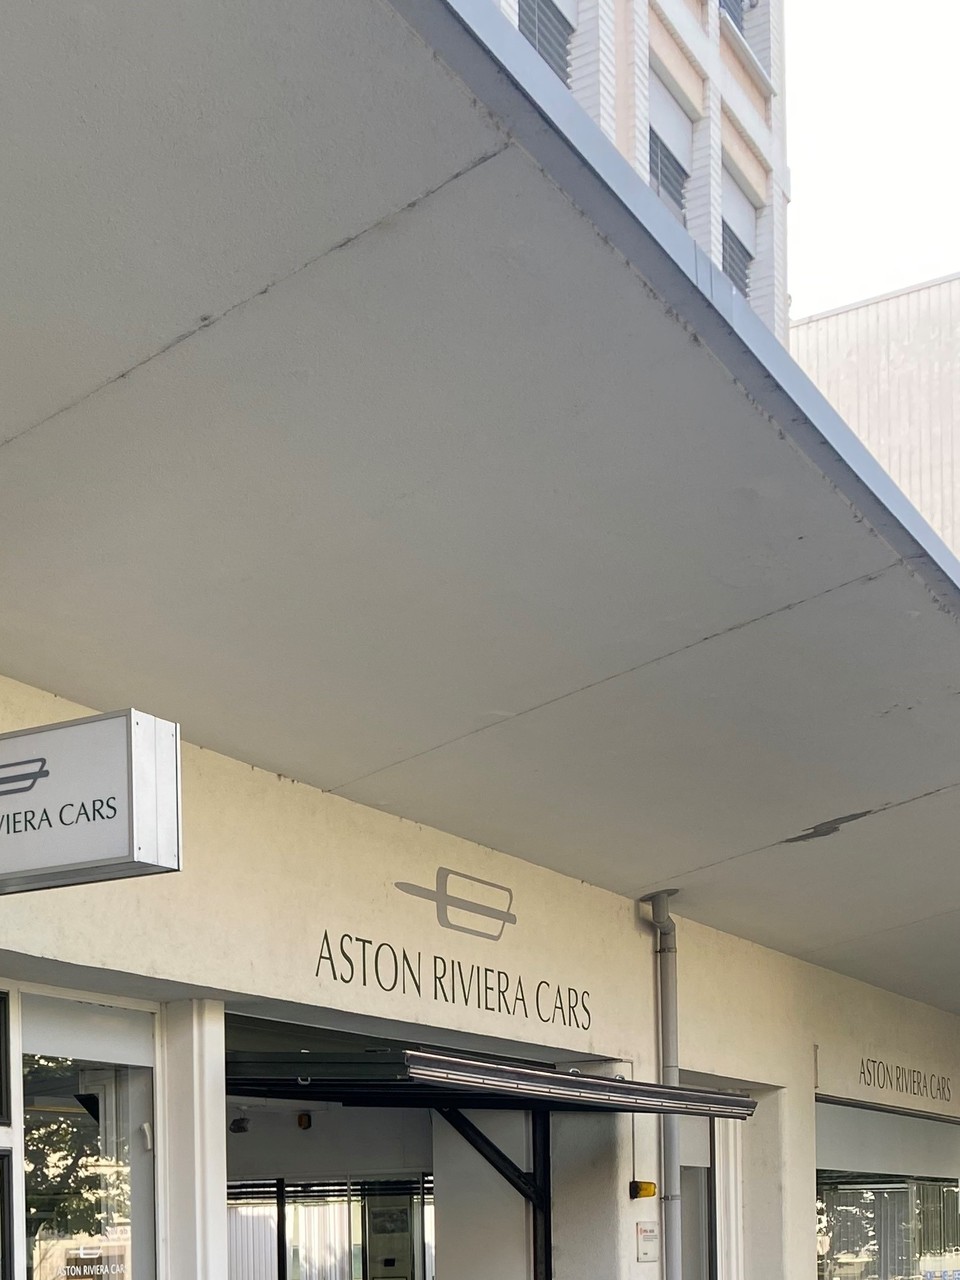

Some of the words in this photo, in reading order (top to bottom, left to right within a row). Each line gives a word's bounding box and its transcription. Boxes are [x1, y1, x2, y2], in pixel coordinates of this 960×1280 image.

[59, 796, 117, 827] CARS
[315, 929, 422, 997] ASTON
[433, 955, 528, 1019] RIVIERA
[535, 980, 591, 1031] CARS
[859, 1058, 893, 1090] ASTON
[895, 1065, 929, 1098] RIVIERA
[929, 1074, 952, 1102] CARS
[57, 1265, 82, 1276] ASTON
[83, 1264, 110, 1275] RIVIERA
